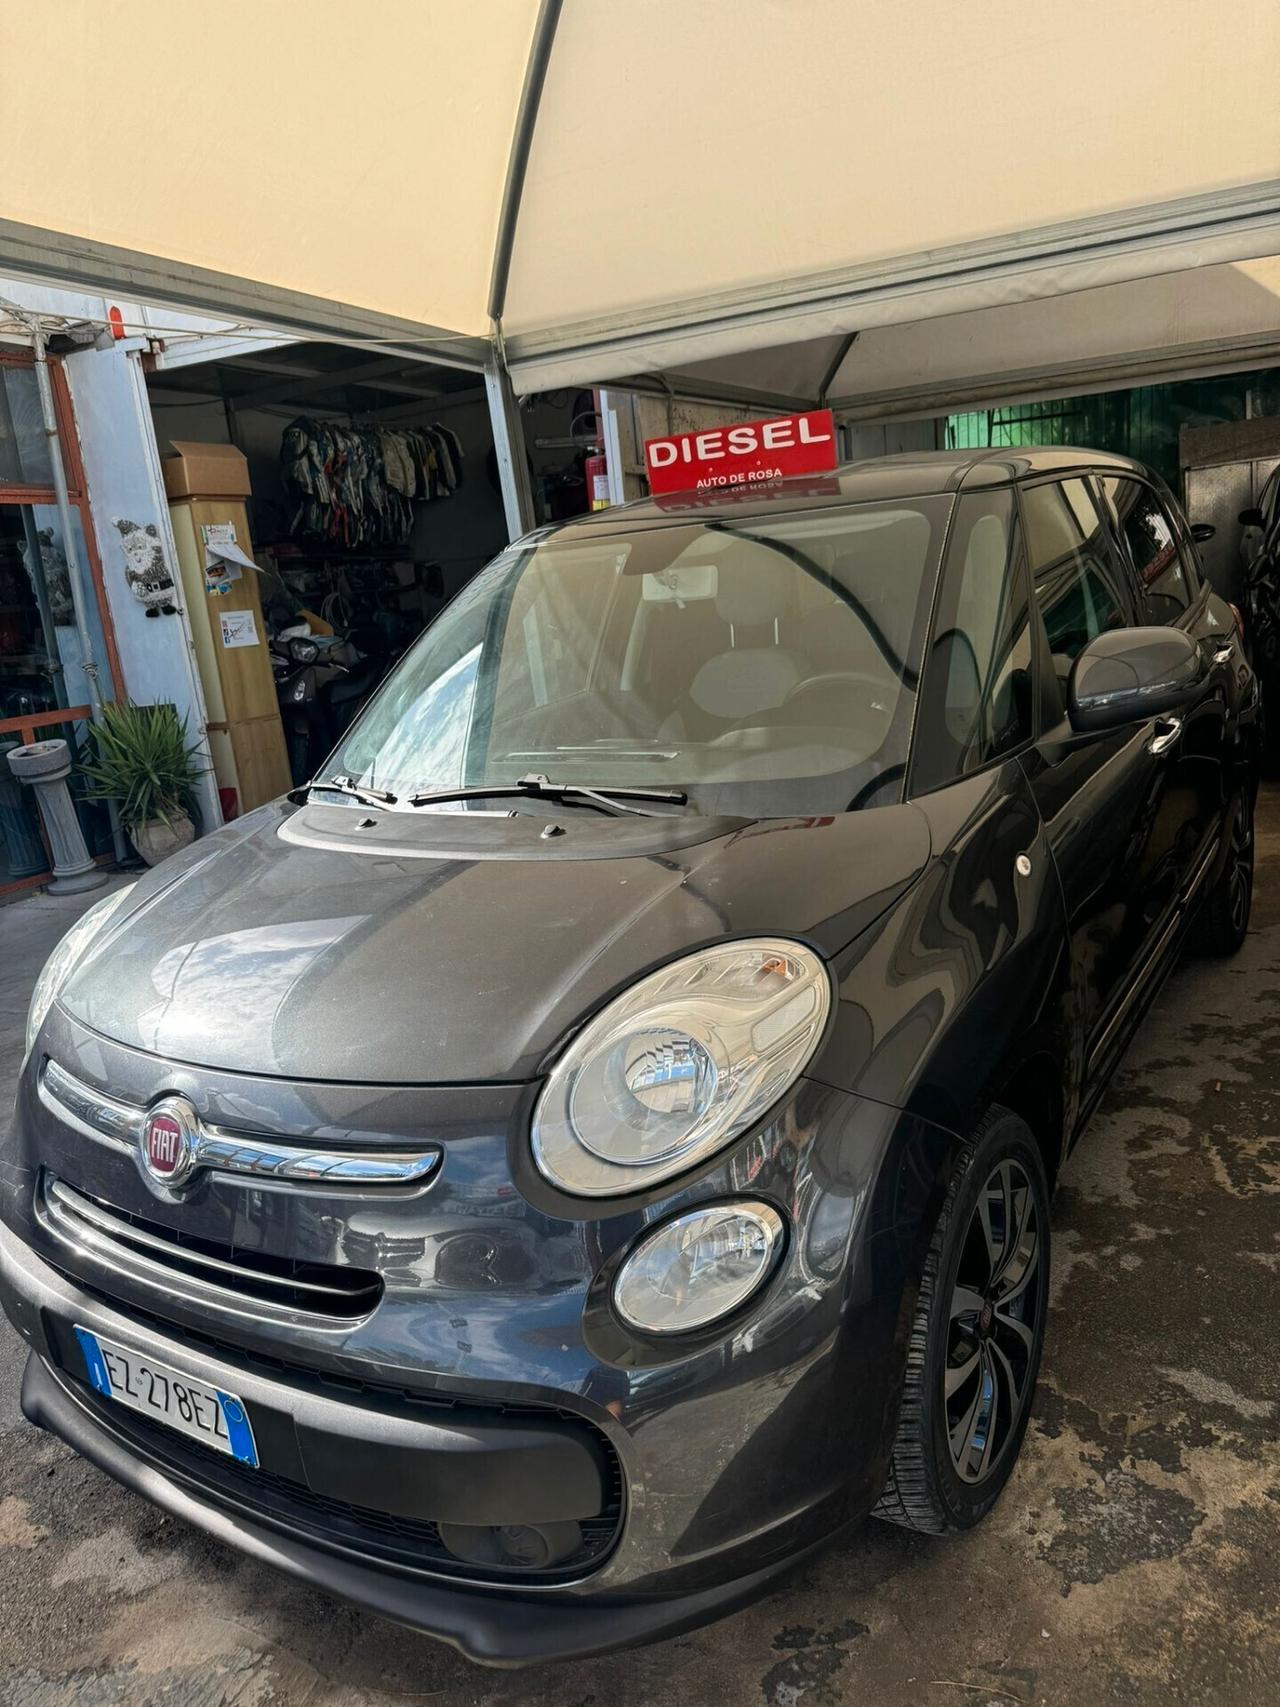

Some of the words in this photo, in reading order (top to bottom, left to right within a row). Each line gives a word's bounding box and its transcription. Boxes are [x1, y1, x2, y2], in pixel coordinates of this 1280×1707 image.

[649, 418, 831, 467] DIESEL
[696, 477, 727, 488] AUTO
[729, 473, 746, 482] DE
[748, 468, 782, 480] ROSA
[152, 1127, 178, 1162] FIAT
